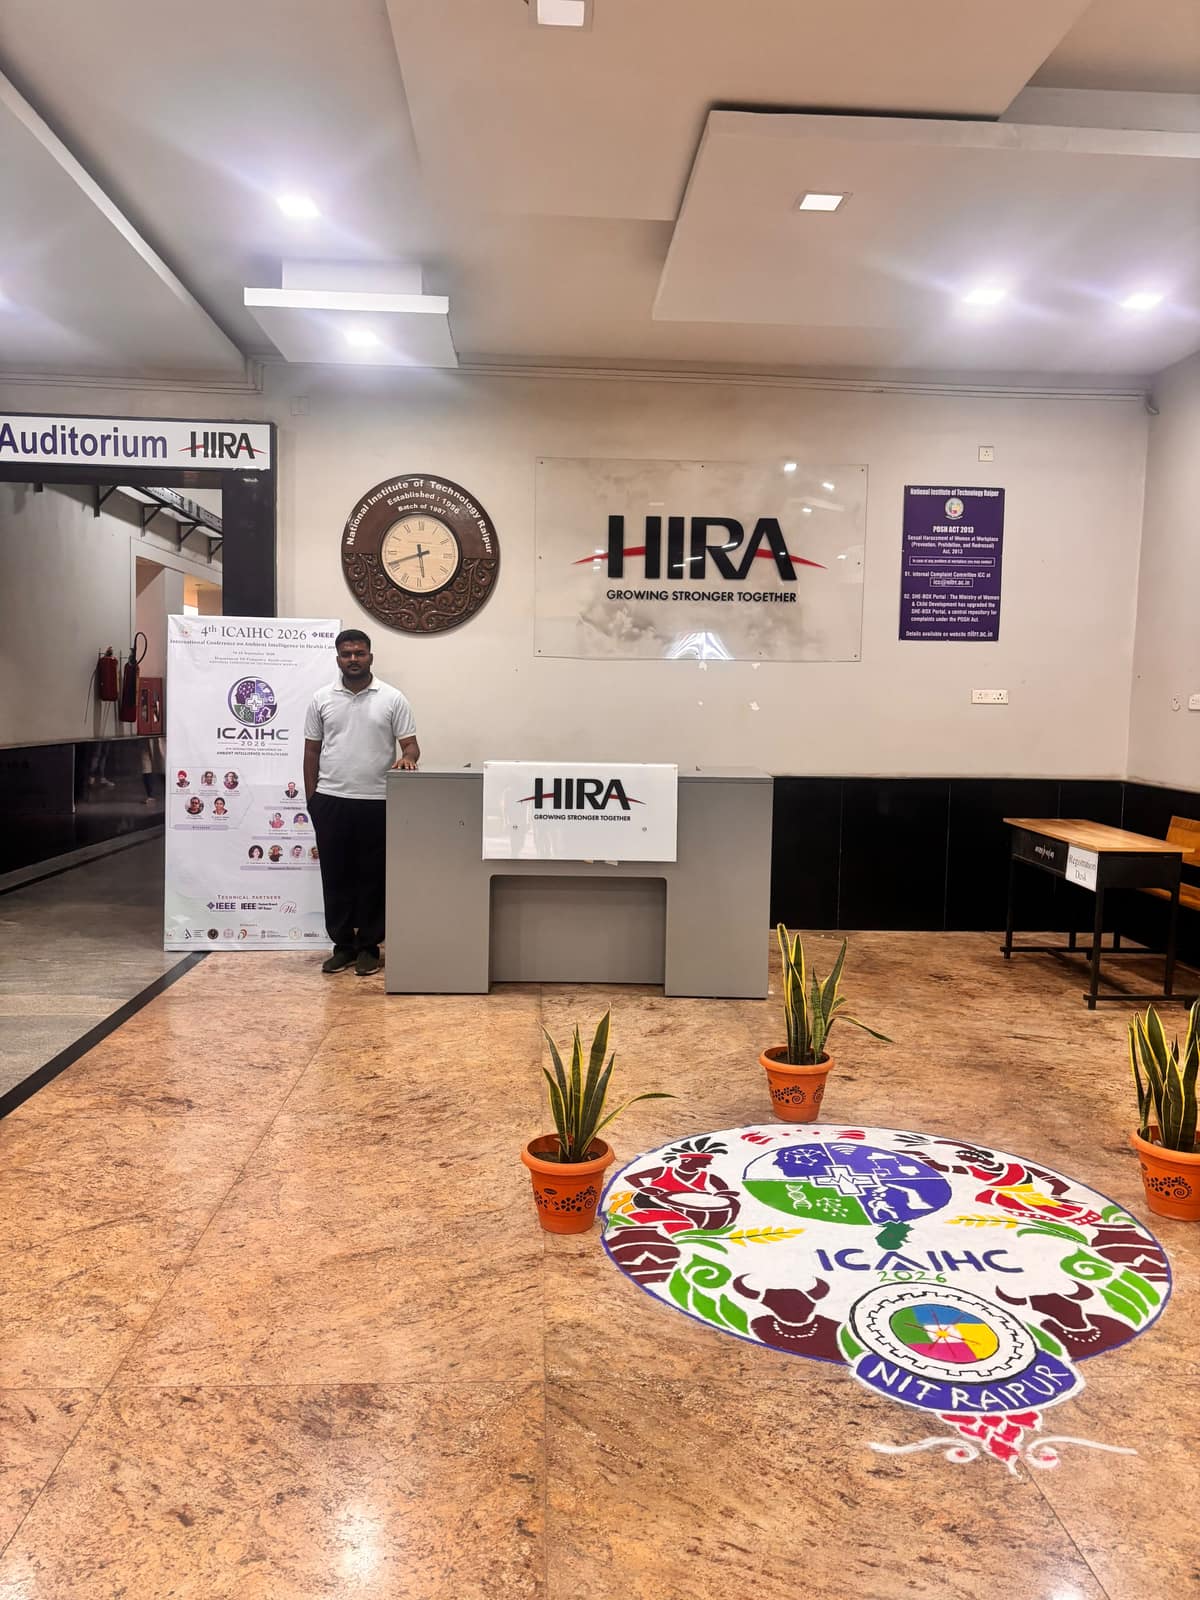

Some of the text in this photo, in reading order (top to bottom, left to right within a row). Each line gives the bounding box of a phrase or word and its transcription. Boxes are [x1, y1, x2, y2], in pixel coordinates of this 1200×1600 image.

[0, 423, 167, 458] Auditorium
[190, 431, 256, 459] HIRA
[387, 491, 435, 506] Established
[910, 488, 930, 496] National
[957, 489, 983, 497] Technology
[398, 503, 418, 512] Batch
[346, 479, 493, 554] National Institute of Technology Raipur
[607, 515, 797, 581] HIRA
[606, 589, 797, 603] GROWING STRONGER TOGETHER
[201, 625, 307, 640] 4th ICAIHC 2026
[217, 728, 289, 740] ICAIHC
[534, 778, 631, 810] HIRA
[216, 902, 236, 910] IEEE
[241, 902, 257, 910] IEEE
[816, 1248, 1024, 1273] ICAIHC
[877, 1271, 948, 1283] 2026
[867, 1361, 1069, 1410] NIT RAIPUR
